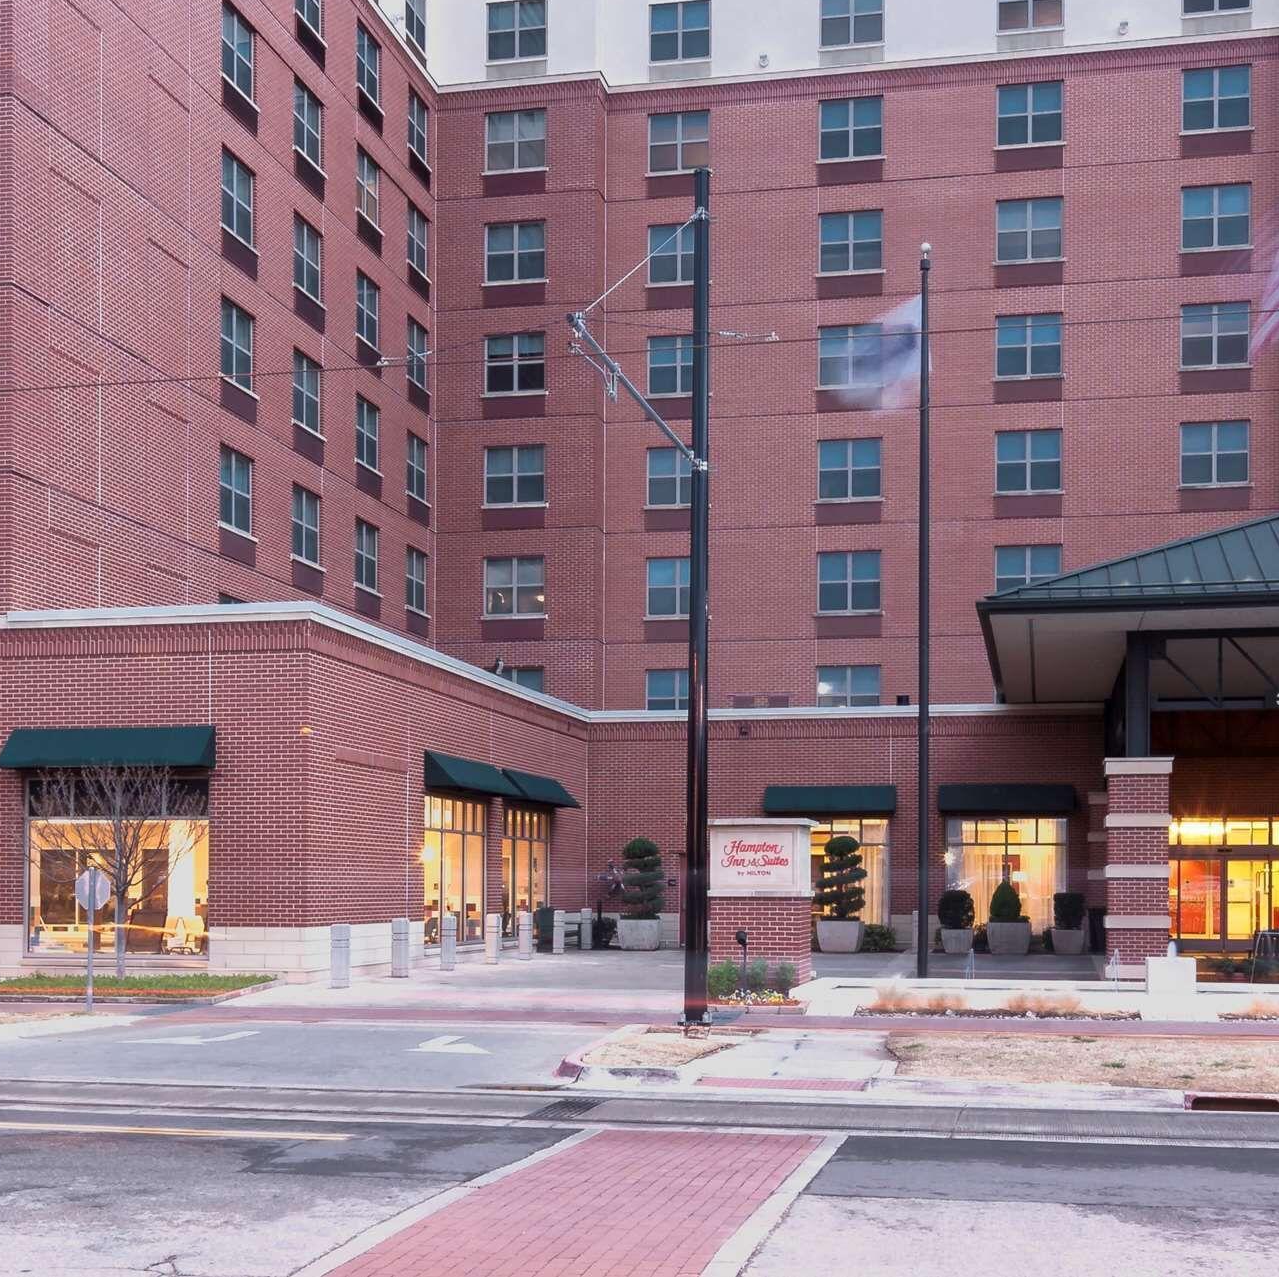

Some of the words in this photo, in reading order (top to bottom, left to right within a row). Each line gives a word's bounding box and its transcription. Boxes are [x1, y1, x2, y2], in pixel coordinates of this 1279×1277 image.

[723, 840, 784, 855] Hampton
[721, 855, 751, 867] Inn
[757, 855, 789, 867] Suites
